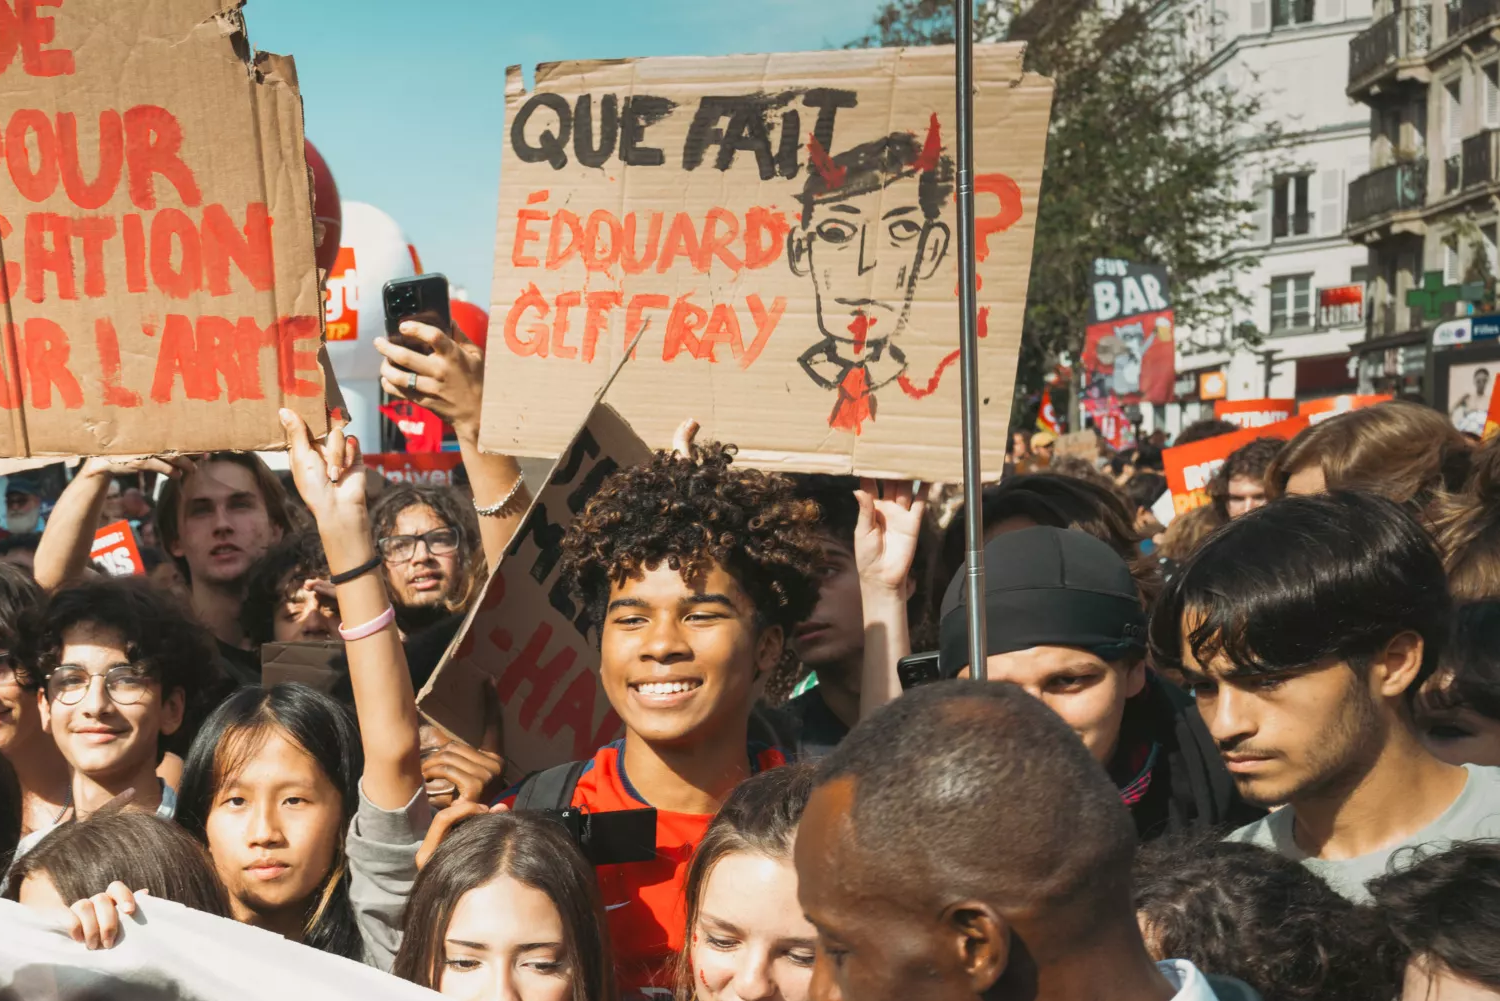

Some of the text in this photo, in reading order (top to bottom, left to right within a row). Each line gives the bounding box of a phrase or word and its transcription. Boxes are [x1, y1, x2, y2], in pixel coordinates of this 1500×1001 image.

[511, 88, 858, 180] QUE FAIT
[512, 190, 790, 274] ÉDOUARD
[1093, 274, 1168, 320] BAR
